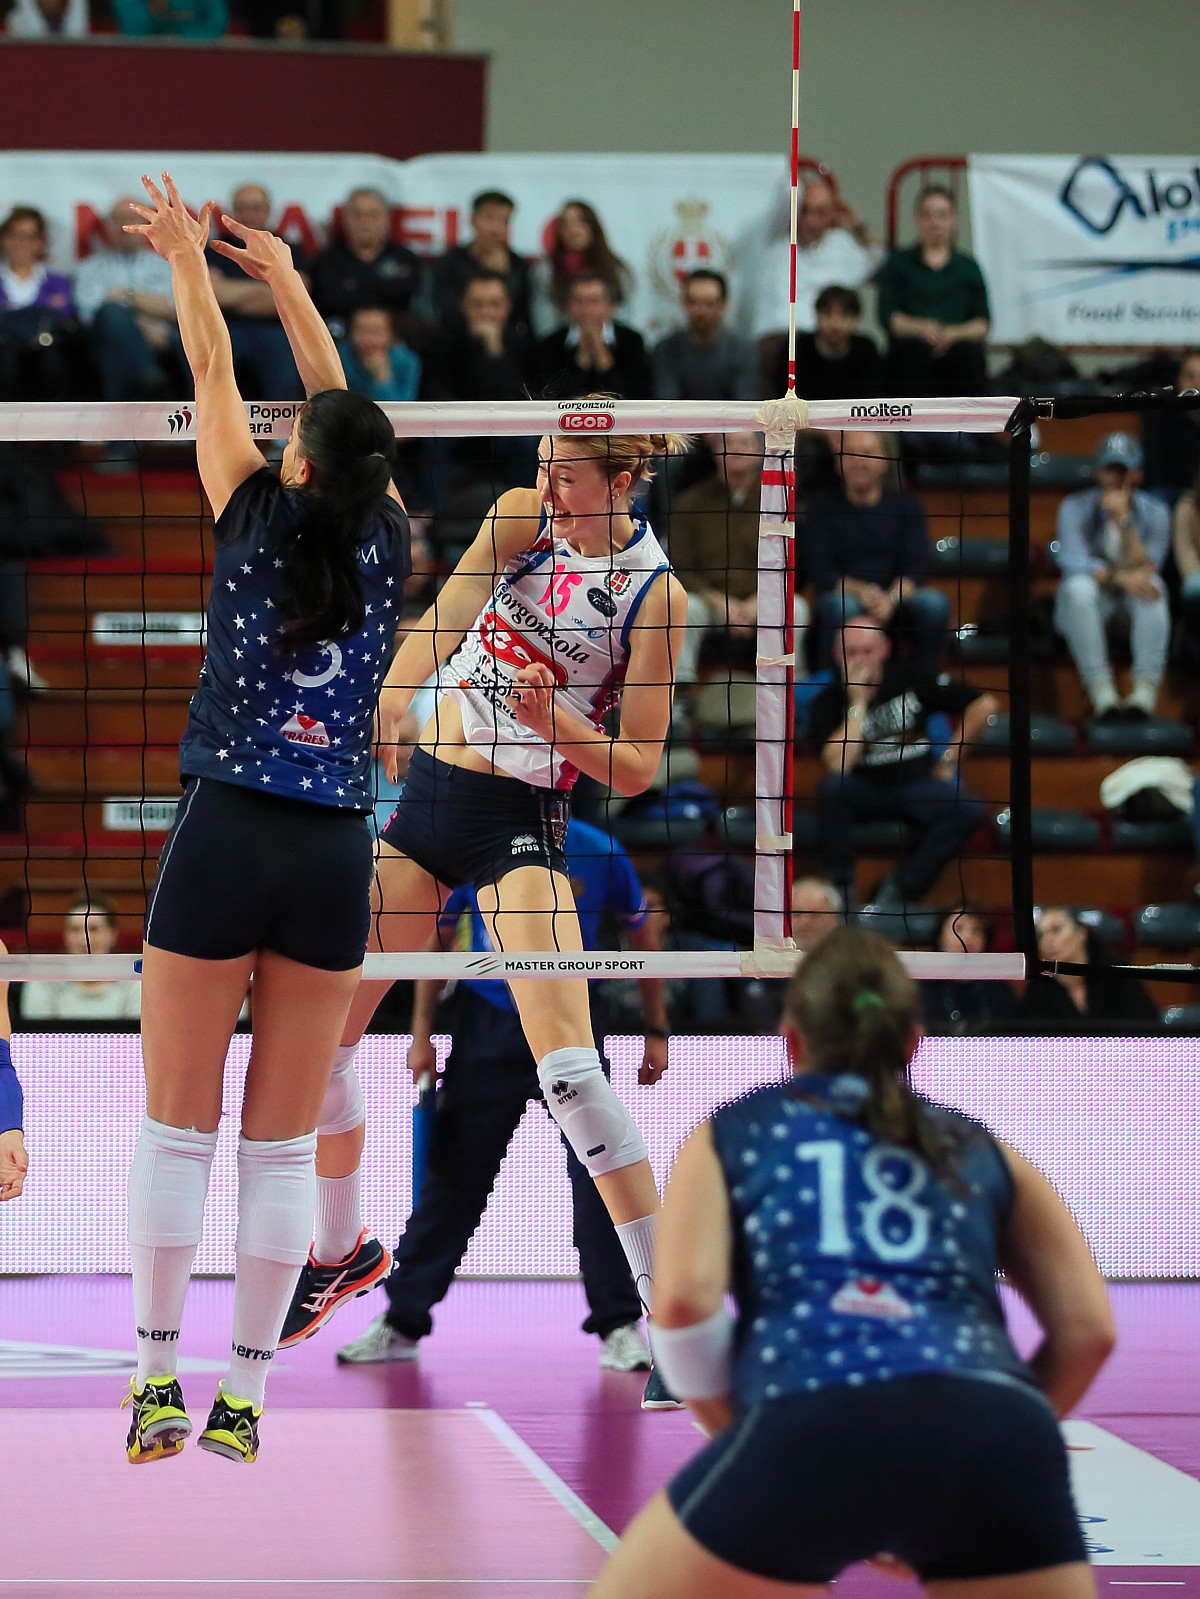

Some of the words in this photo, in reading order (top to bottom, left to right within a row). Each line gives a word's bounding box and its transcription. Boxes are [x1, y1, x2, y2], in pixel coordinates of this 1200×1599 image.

[557, 401, 615, 411] Gorgonzola
[850, 403, 912, 417] molten
[249, 422, 272, 434] ara
[565, 416, 608, 428] IGOR
[535, 564, 583, 617] 15
[494, 582, 590, 664] Gorgonzola
[511, 843, 540, 855] errea
[505, 961, 555, 970] MASTER
[558, 961, 602, 970] GROUP
[605, 960, 645, 970] SPORT
[557, 1088, 579, 1105] errea
[794, 1139, 931, 1262] 18
